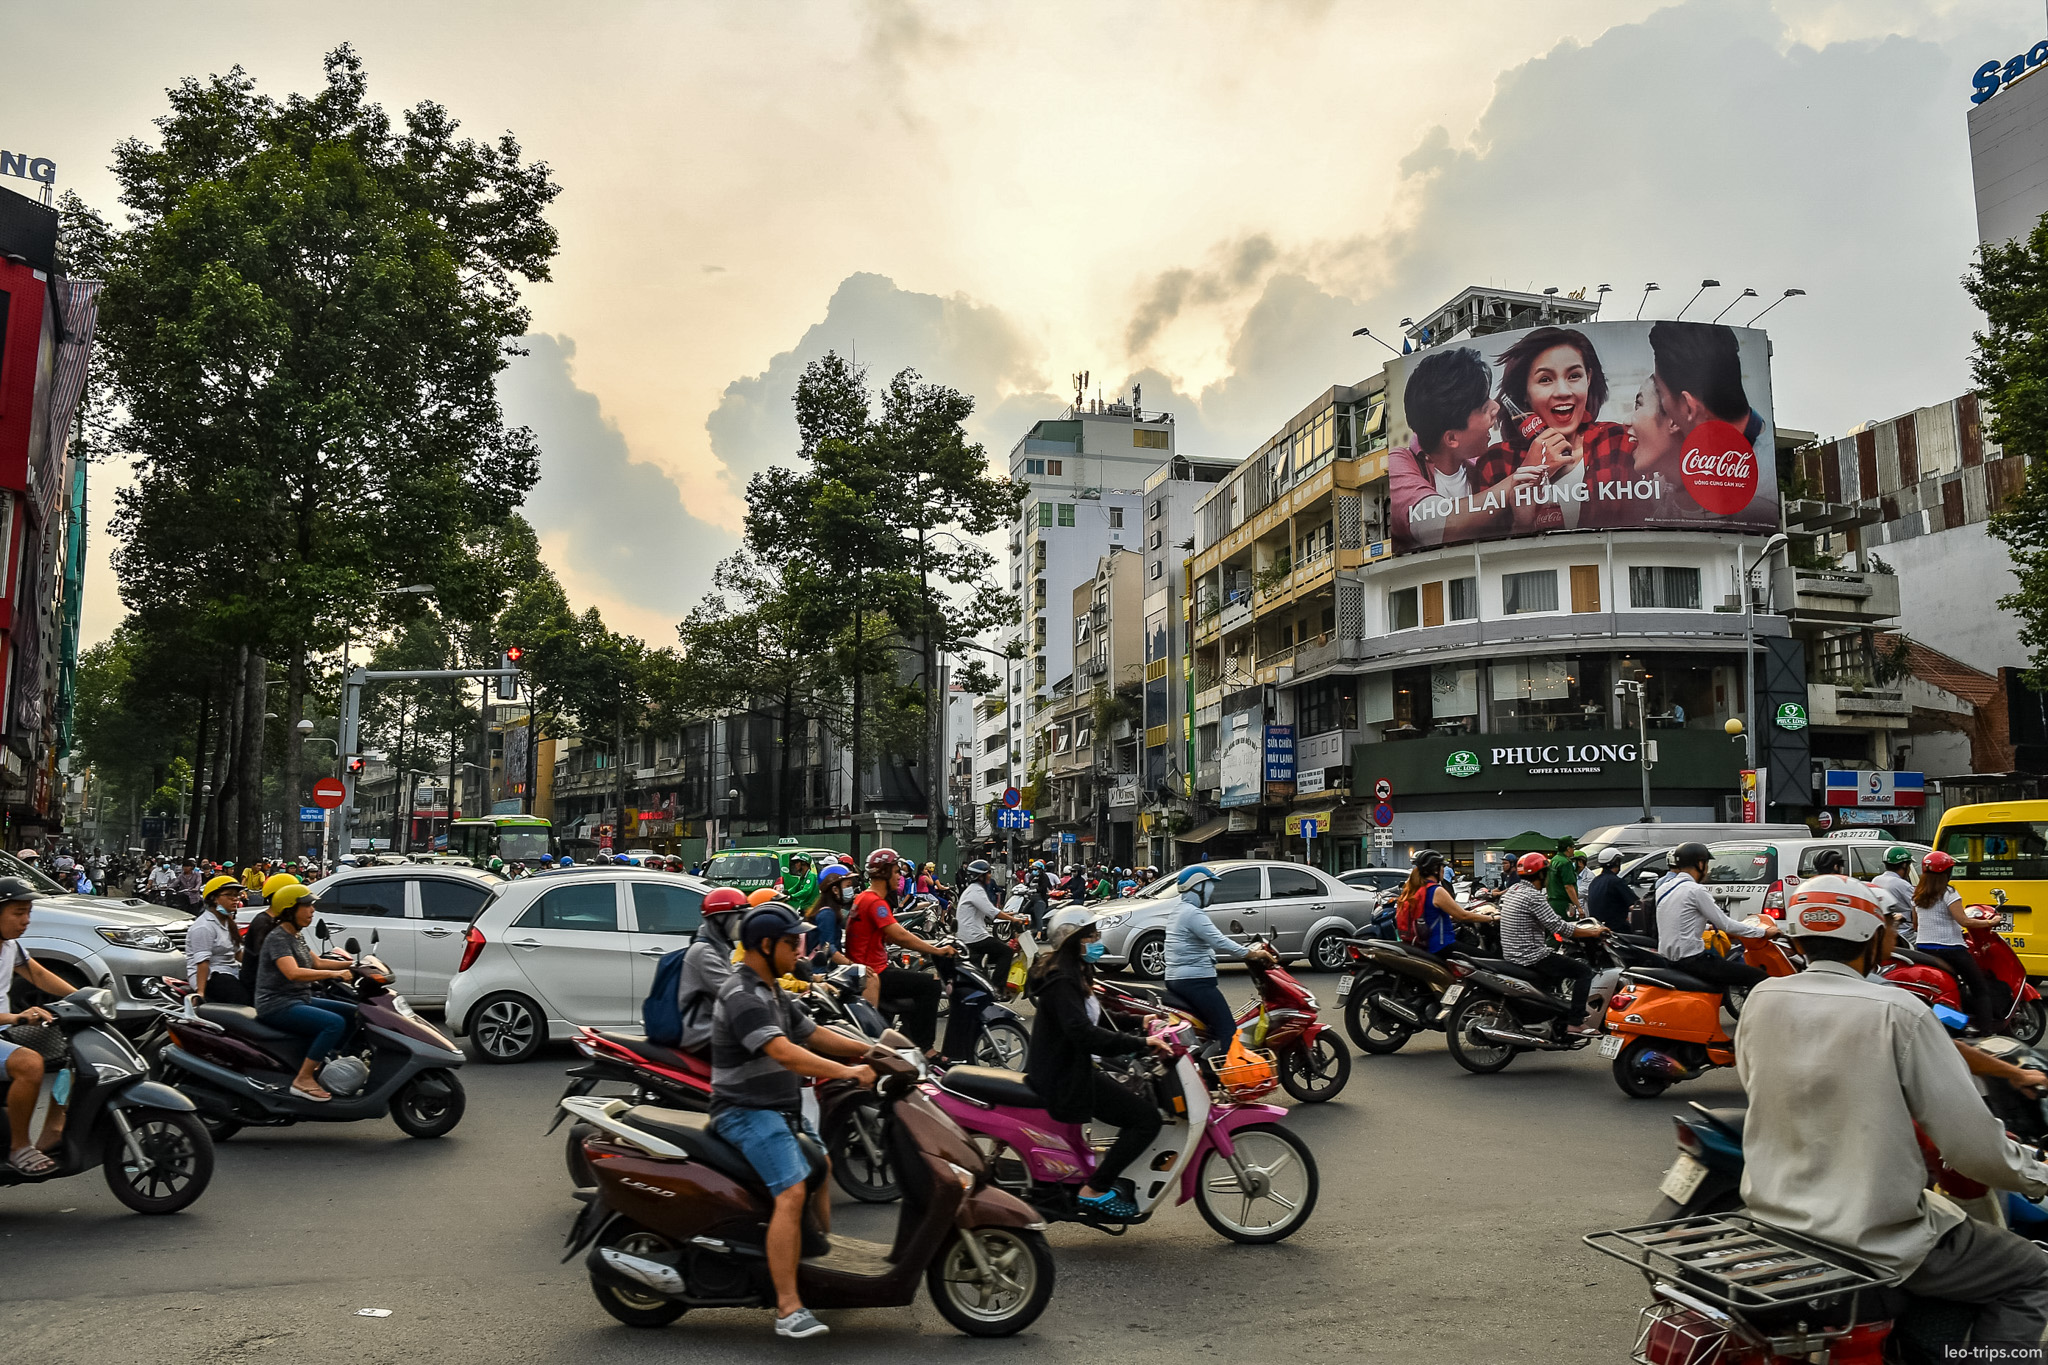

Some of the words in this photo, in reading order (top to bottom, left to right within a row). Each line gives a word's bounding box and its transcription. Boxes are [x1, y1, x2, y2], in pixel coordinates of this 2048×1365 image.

[1, 150, 56, 184] NG
[1468, 488, 1506, 515] LẠI
[1599, 475, 1661, 500] KHỞI
[1491, 745, 1560, 765] PHUC
[1566, 743, 1638, 763] LONG
[1446, 765, 1463, 773] PHUC
